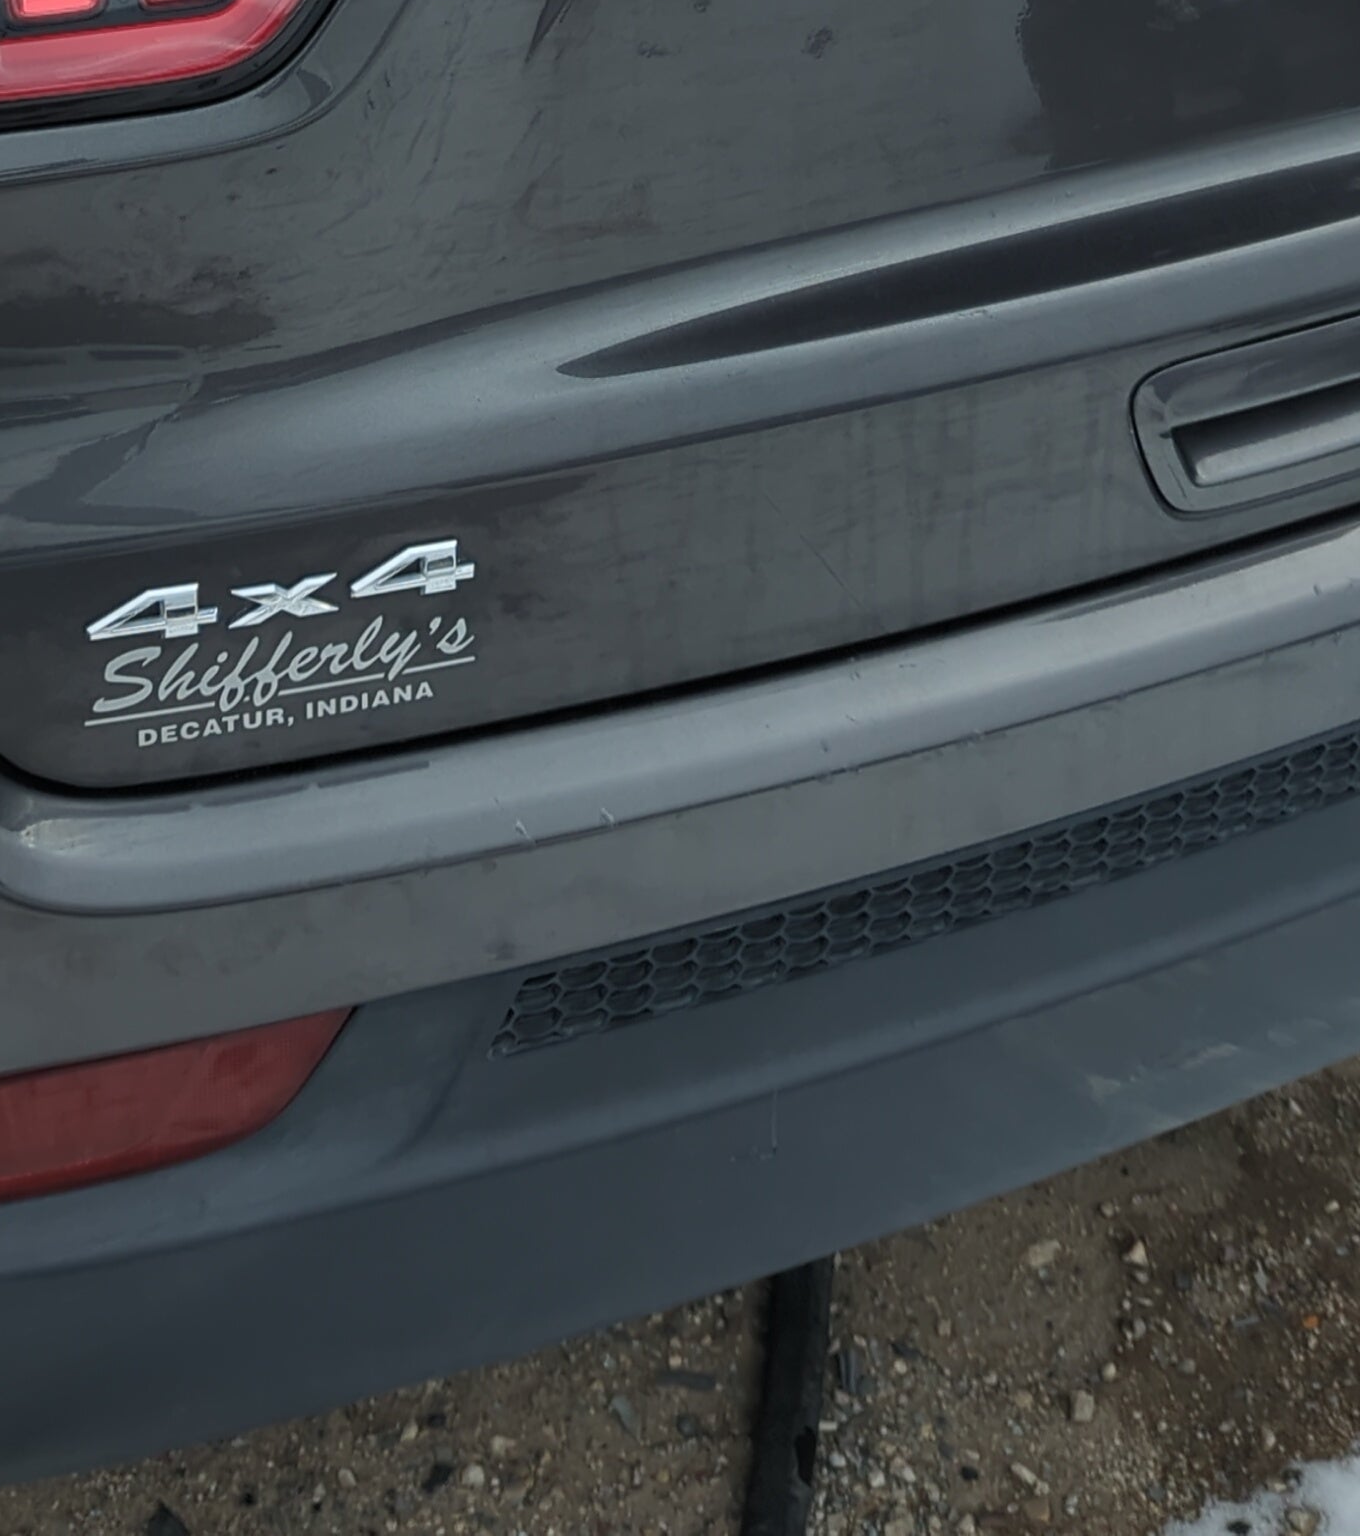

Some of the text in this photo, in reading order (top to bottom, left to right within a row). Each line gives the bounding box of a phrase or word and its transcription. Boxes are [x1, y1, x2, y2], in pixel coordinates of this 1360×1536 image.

[92, 615, 476, 712] Shifferly's
[137, 680, 434, 747] DECATUR, INDIANA
